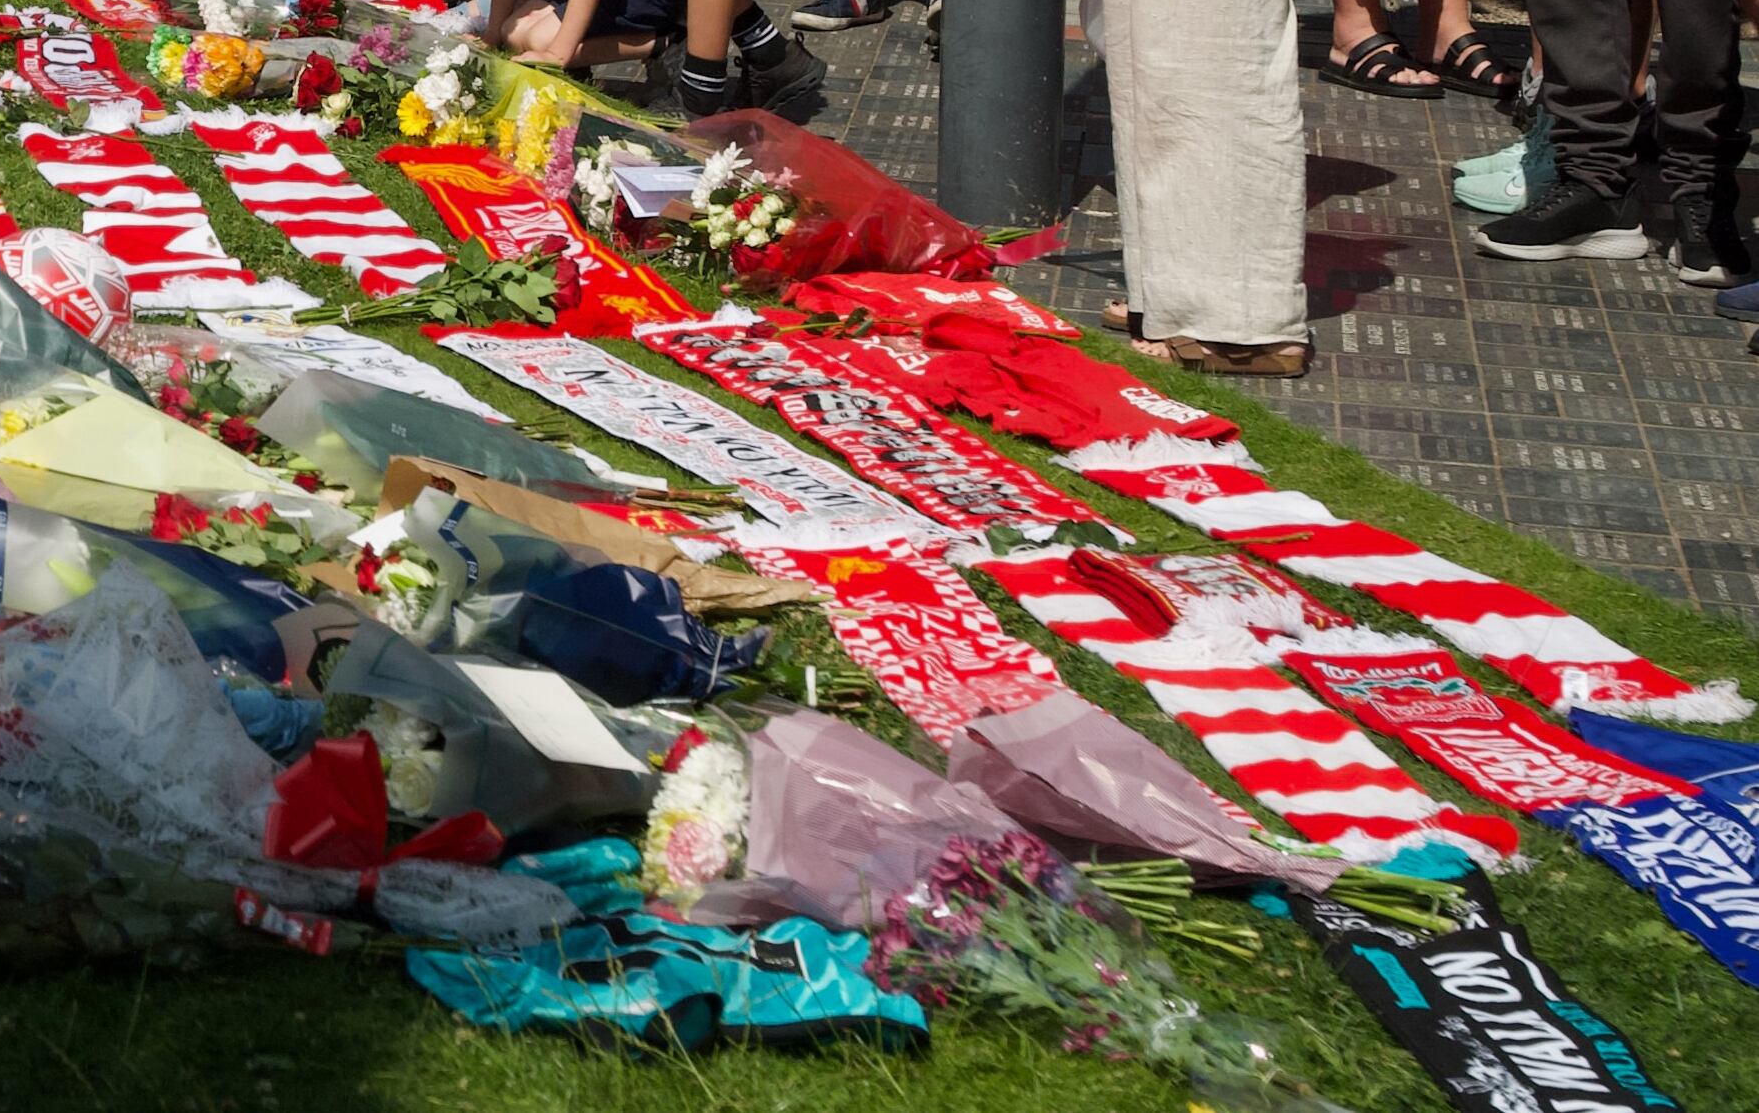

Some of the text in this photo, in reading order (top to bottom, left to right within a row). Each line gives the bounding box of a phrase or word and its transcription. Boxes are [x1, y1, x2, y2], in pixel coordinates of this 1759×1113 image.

[1311, 660, 1442, 680] LIVERPOOL
[1420, 950, 1611, 1094] WALK ON
